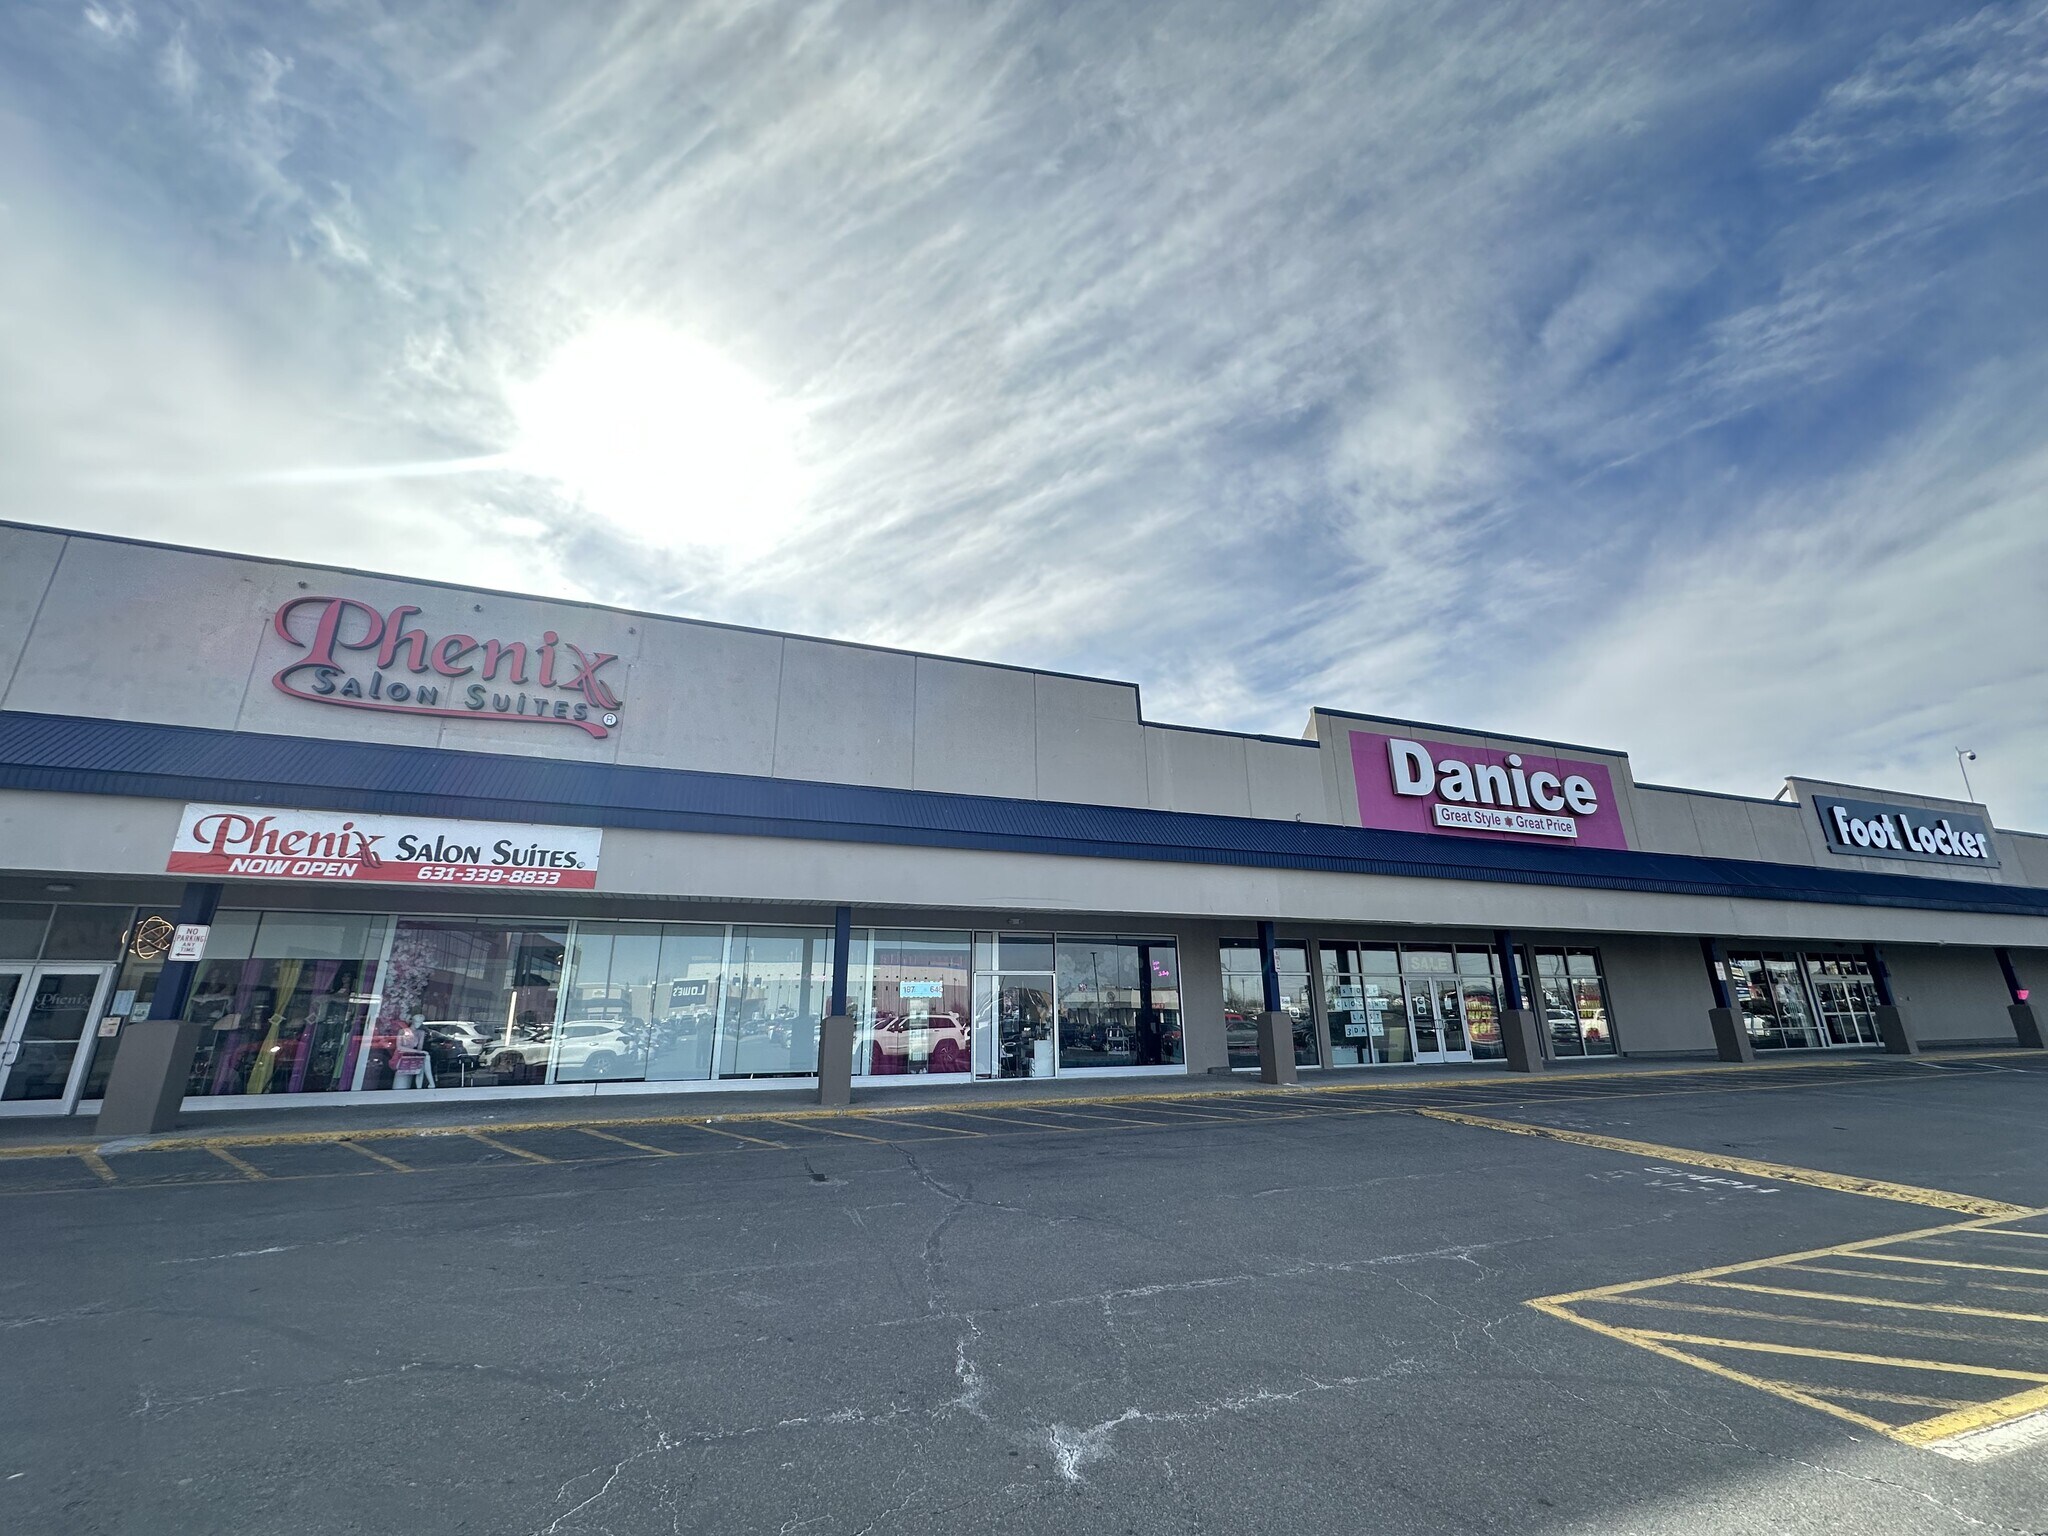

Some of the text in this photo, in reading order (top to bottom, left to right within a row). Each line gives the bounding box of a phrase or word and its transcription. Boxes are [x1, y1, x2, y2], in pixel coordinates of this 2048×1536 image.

[273, 596, 622, 711] Phenix
[1387, 738, 1598, 815] Danice
[1441, 807, 1572, 832] Great Style Great Price
[193, 813, 385, 868] Phenix
[1830, 806, 1988, 858] Foot Locker
[228, 857, 358, 877] NOW OPEN
[417, 866, 561, 885] 631-339-8833
[177, 934, 205, 943] PARKING
[1411, 957, 1448, 970] SALE
[1468, 1010, 1492, 1020] MUST
